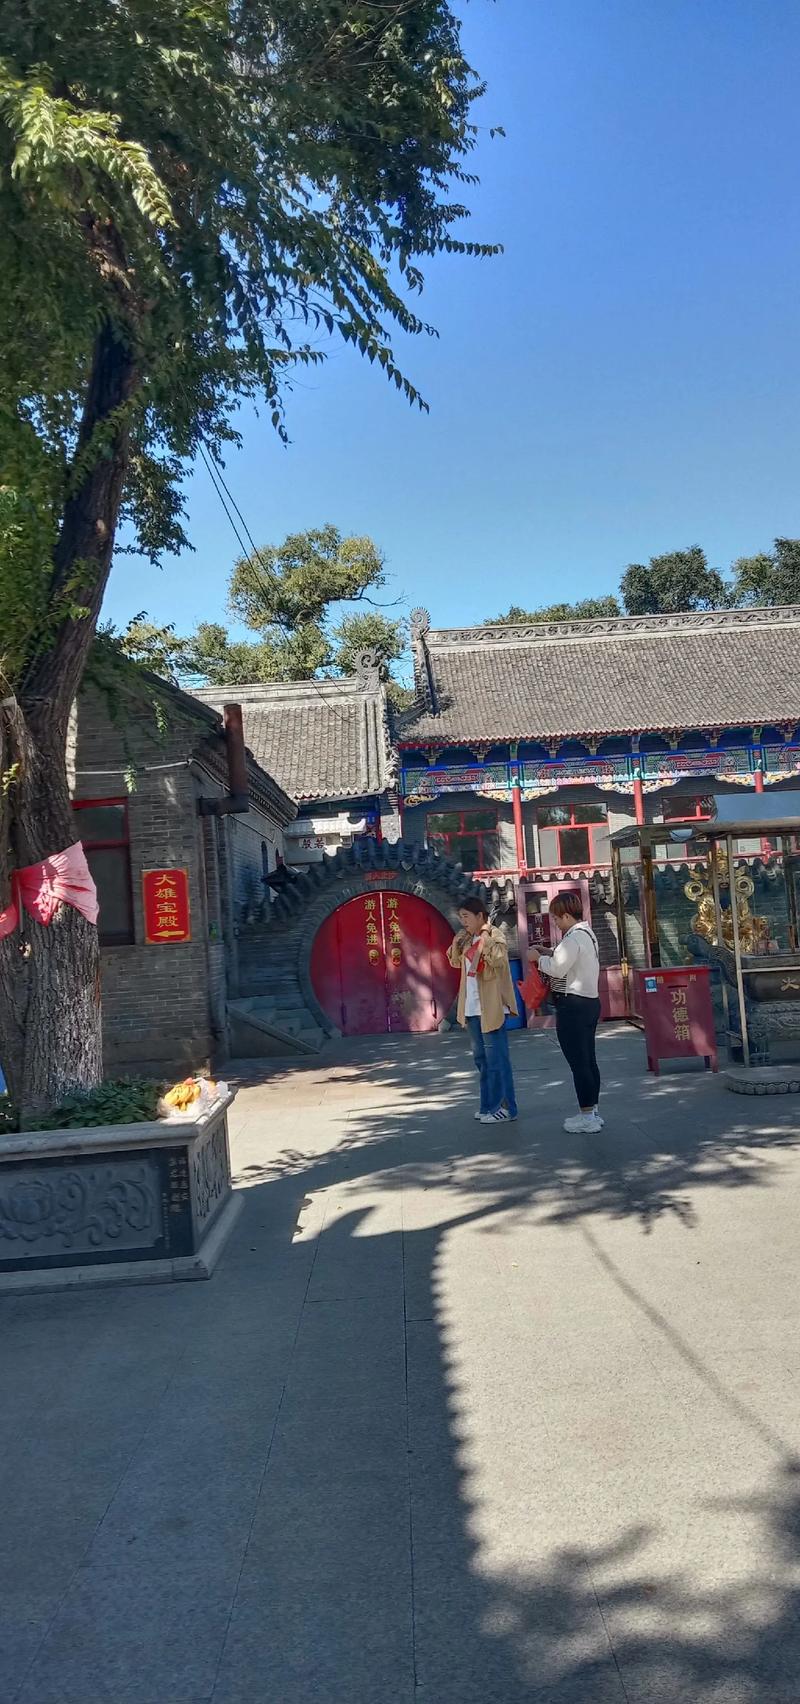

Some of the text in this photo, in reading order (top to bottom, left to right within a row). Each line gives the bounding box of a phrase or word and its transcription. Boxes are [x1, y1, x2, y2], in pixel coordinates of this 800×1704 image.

[154, 874, 178, 928] 大雄宝殿
[364, 899, 378, 946] 游人免进
[386, 897, 401, 945] 游人免进
[670, 988, 690, 1041] 功德箱
